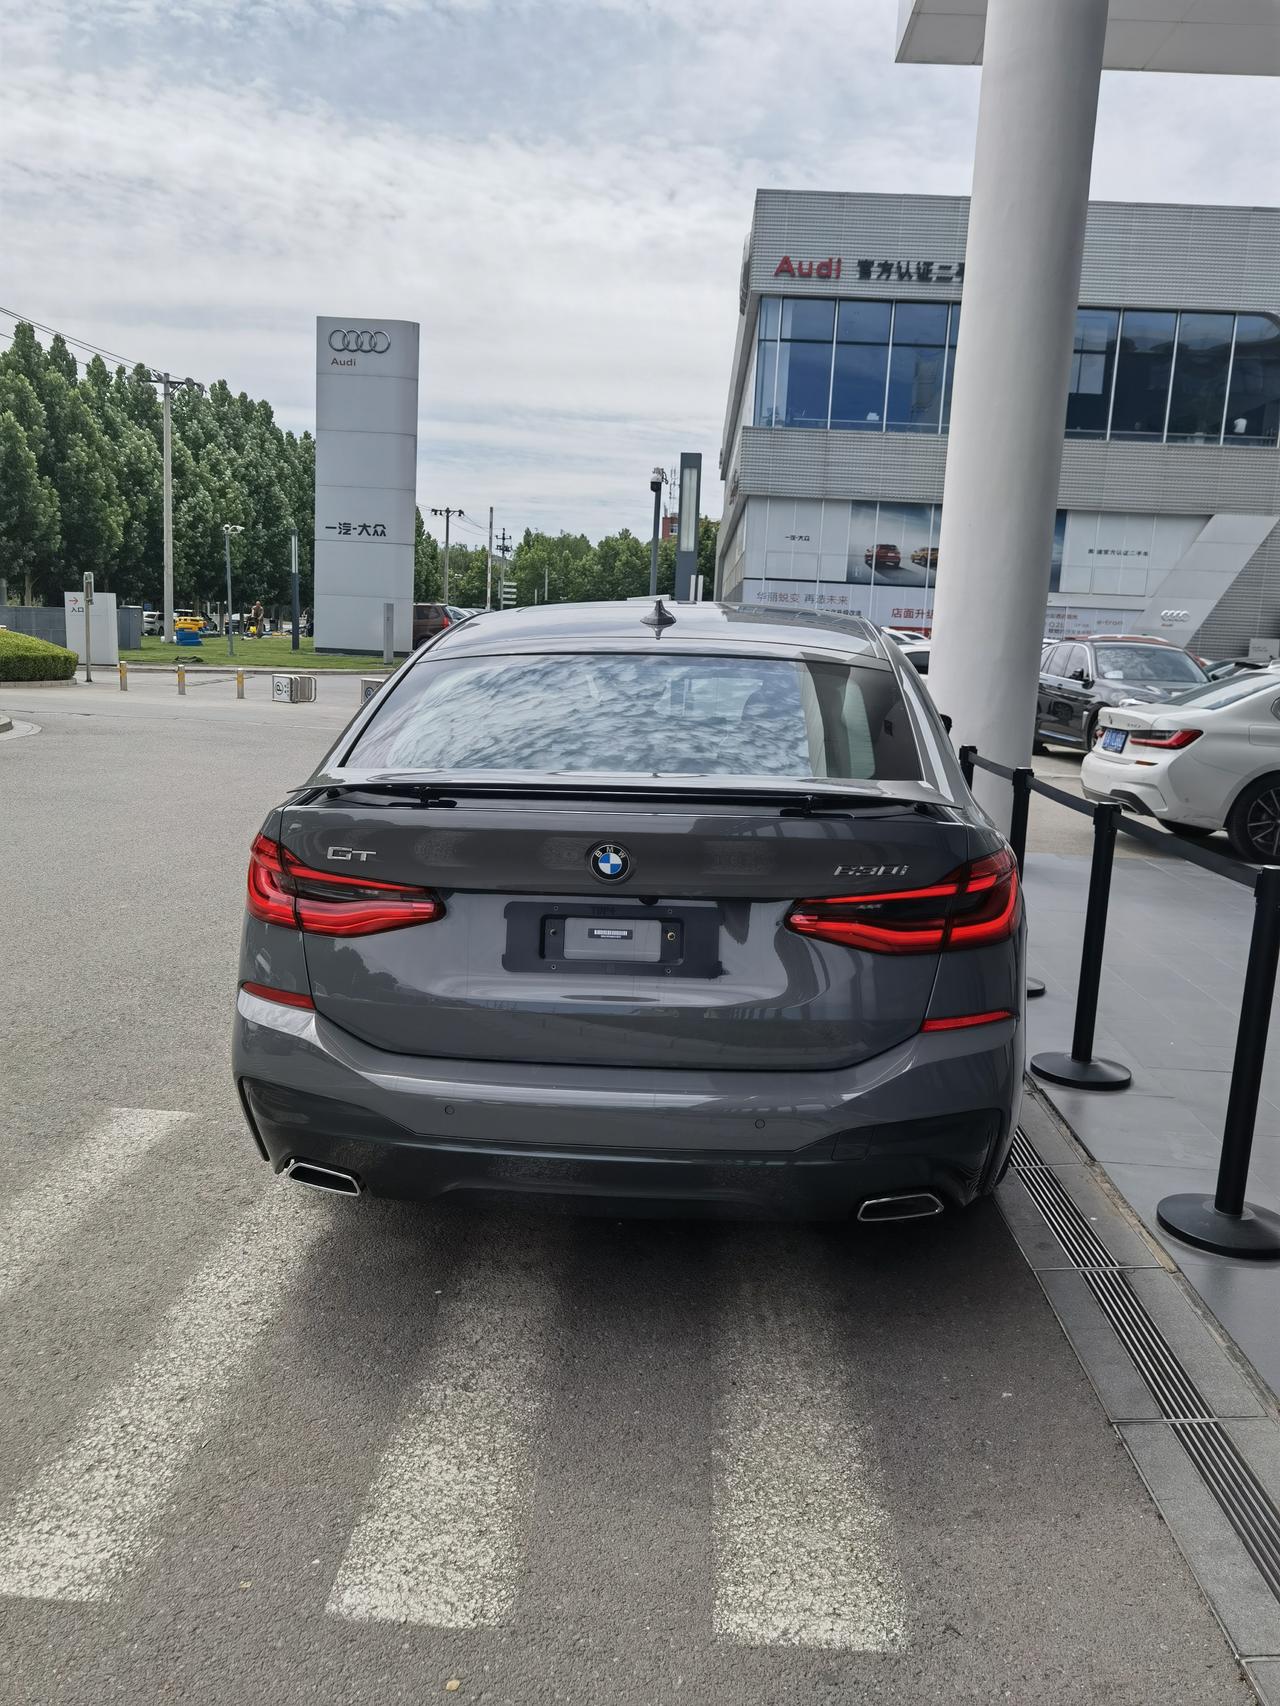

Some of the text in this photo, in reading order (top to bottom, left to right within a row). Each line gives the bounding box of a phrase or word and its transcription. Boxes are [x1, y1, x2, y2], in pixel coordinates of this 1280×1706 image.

[774, 255, 842, 280] Audi
[331, 358, 356, 366] Audi
[325, 522, 387, 537] 一汽-大众
[327, 846, 376, 861] GT
[595, 846, 626, 859] BMW
